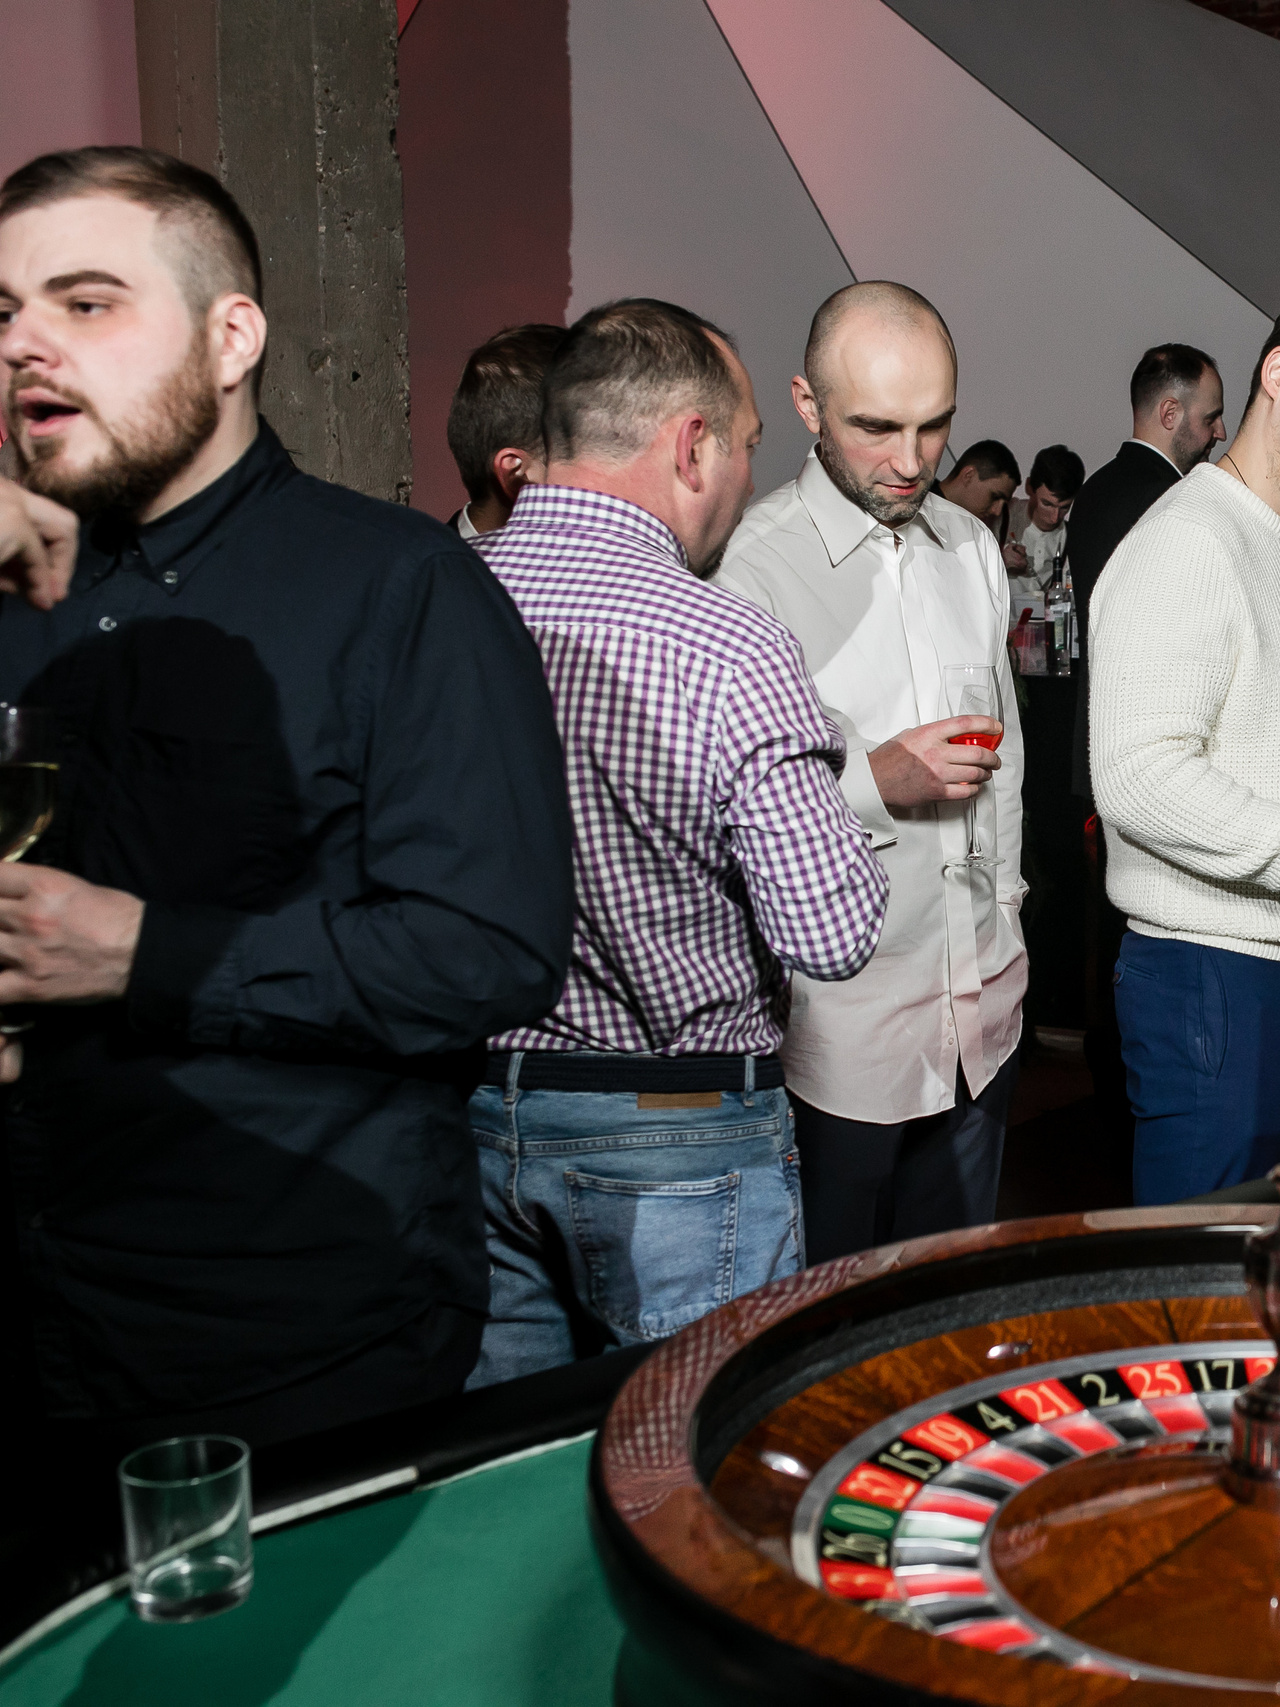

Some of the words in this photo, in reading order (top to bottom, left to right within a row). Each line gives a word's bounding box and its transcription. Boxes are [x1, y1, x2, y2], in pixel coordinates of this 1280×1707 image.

[1080, 1374, 1120, 1407] 2
[1127, 1362, 1183, 1399] 25
[1195, 1360, 1235, 1391] 17
[976, 1401, 1017, 1431] 4
[1014, 1383, 1074, 1422] 21
[915, 1418, 975, 1458] 19
[877, 1441, 943, 1481] 15
[847, 1469, 917, 1510] 32
[830, 1503, 895, 1531] 0
